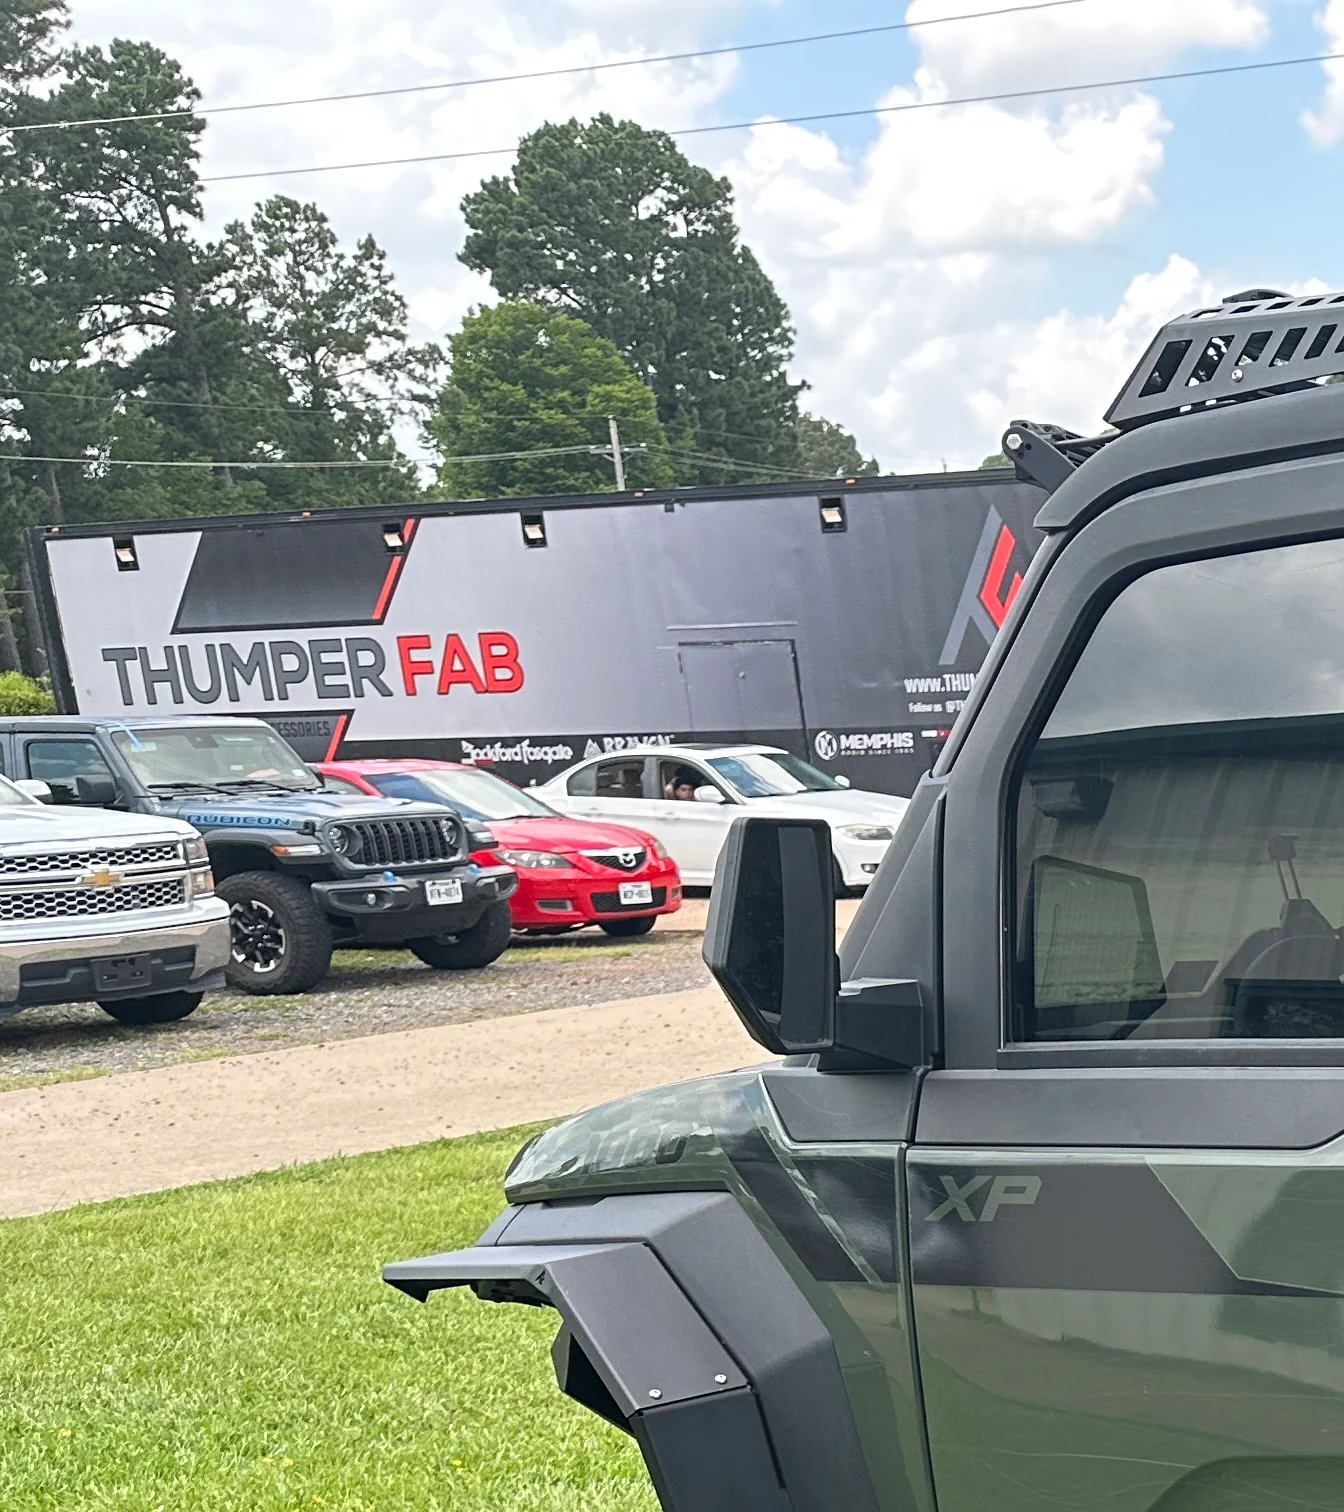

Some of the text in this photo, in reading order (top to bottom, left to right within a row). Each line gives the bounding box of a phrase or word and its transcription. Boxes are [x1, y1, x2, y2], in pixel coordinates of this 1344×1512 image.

[101, 632, 526, 705] THUMPER FAB
[520, 738, 574, 765] Fosgate
[839, 731, 915, 751] MEMPHIS
[185, 813, 292, 827] RUBICON
[923, 1175, 1043, 1222] XP
